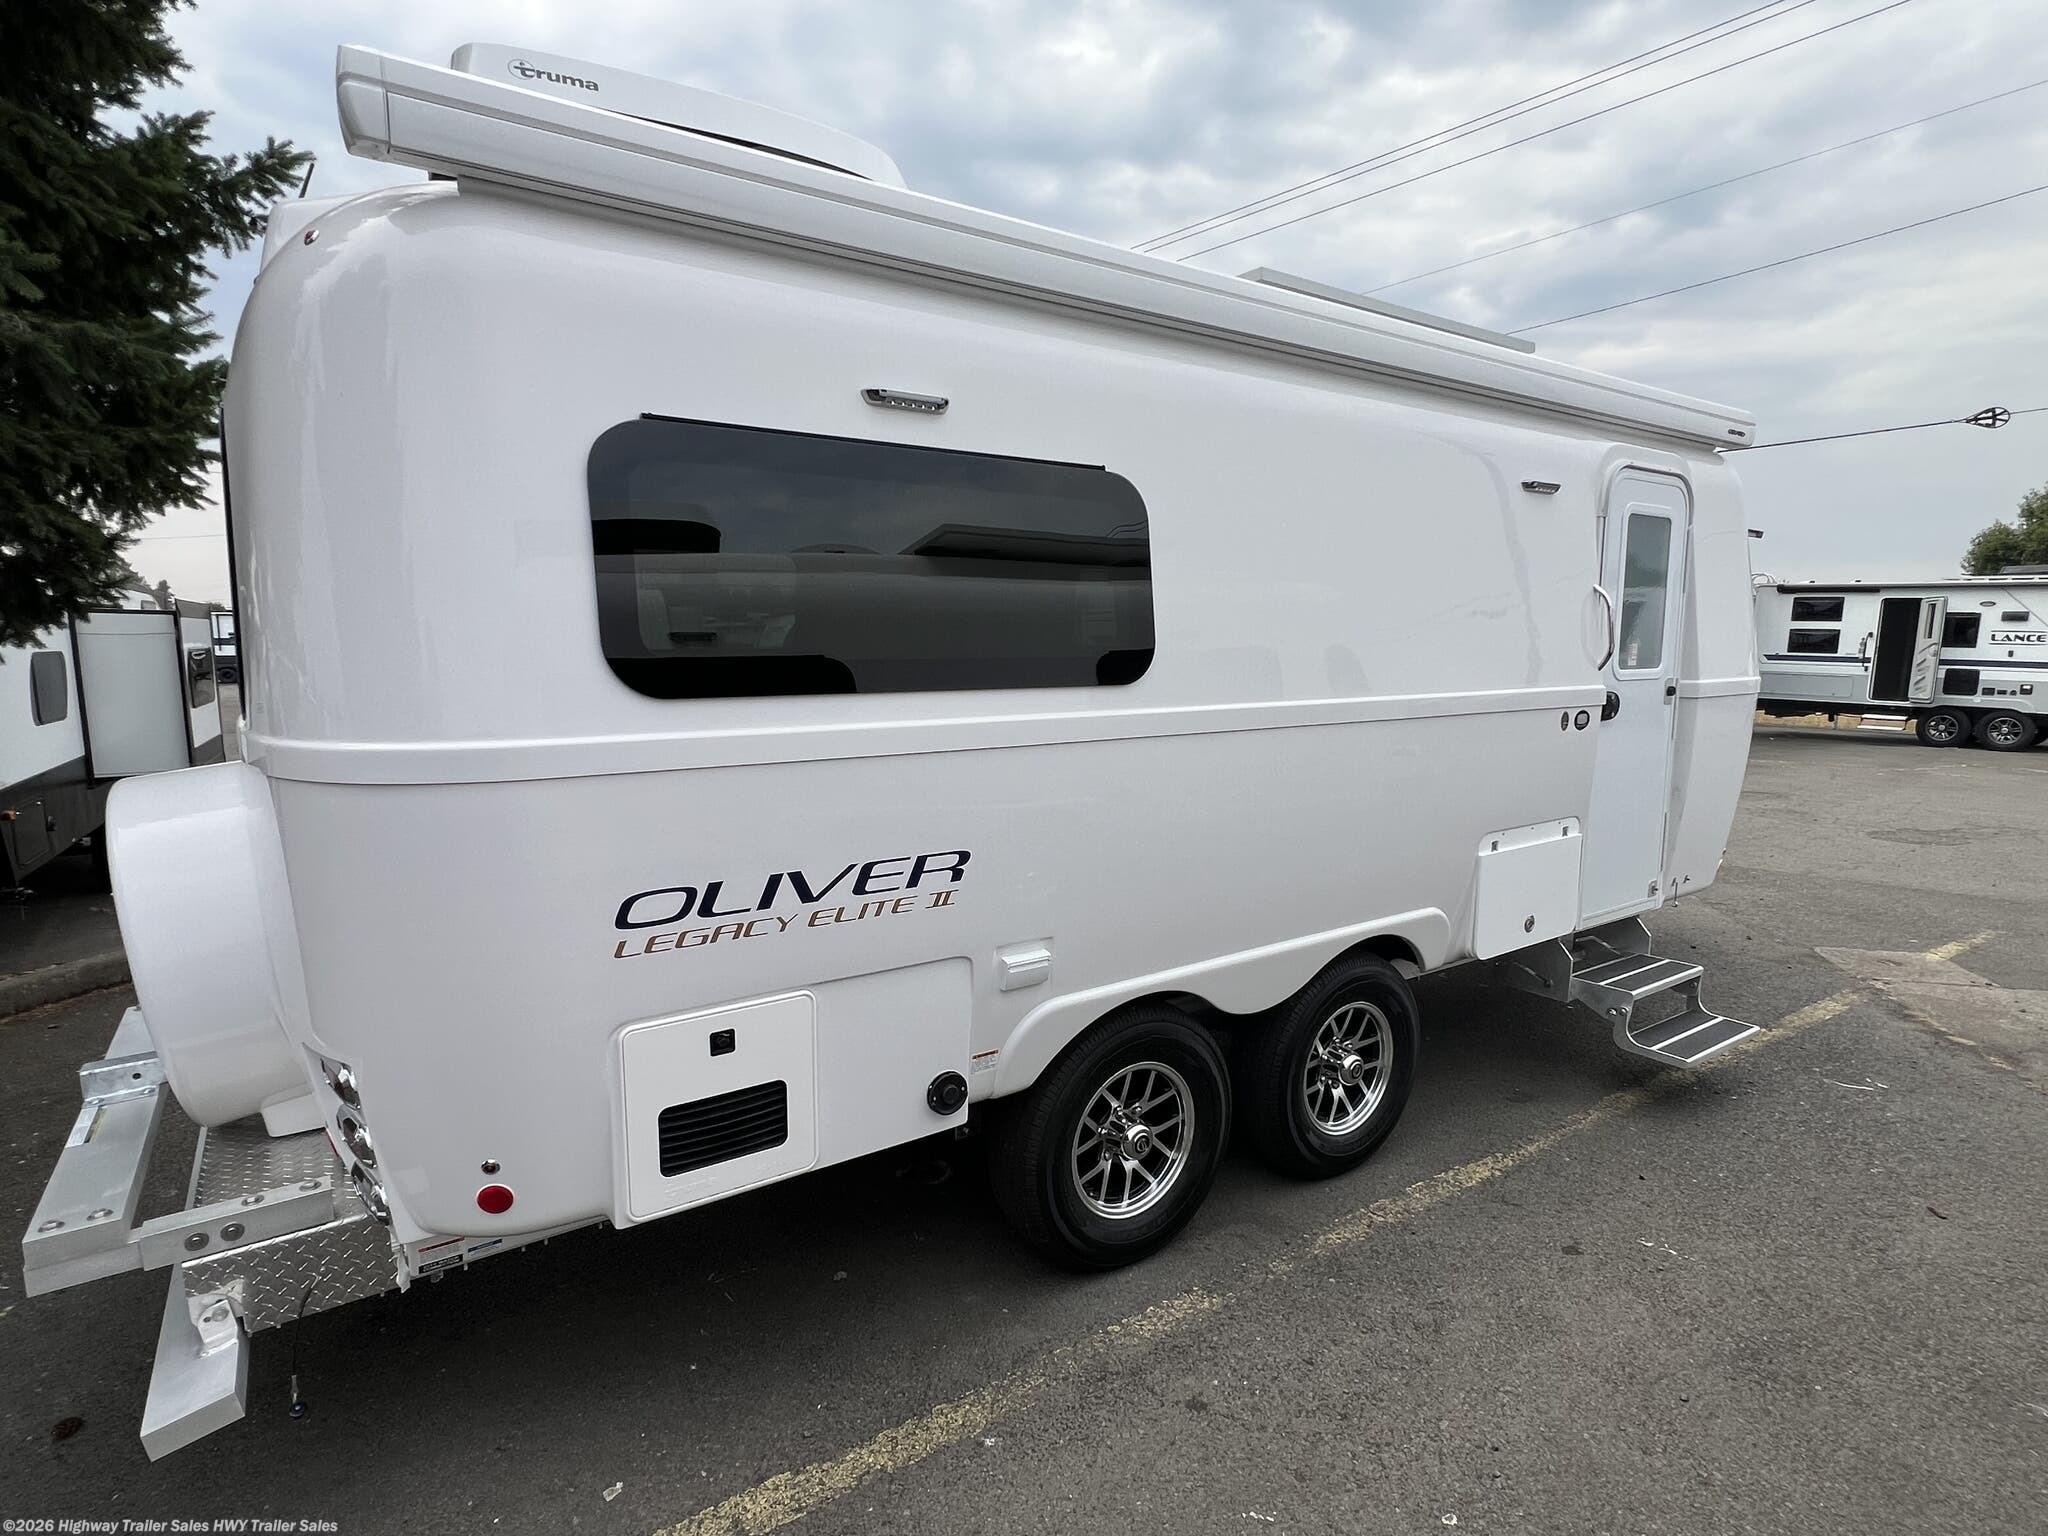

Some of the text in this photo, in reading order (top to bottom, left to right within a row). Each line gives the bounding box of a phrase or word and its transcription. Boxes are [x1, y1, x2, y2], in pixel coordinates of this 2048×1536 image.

[510, 61, 599, 91] truma
[1991, 633, 2047, 643] LANCE
[614, 850, 972, 930] OLIVER
[614, 889, 960, 959] LEGACY ELITE II
